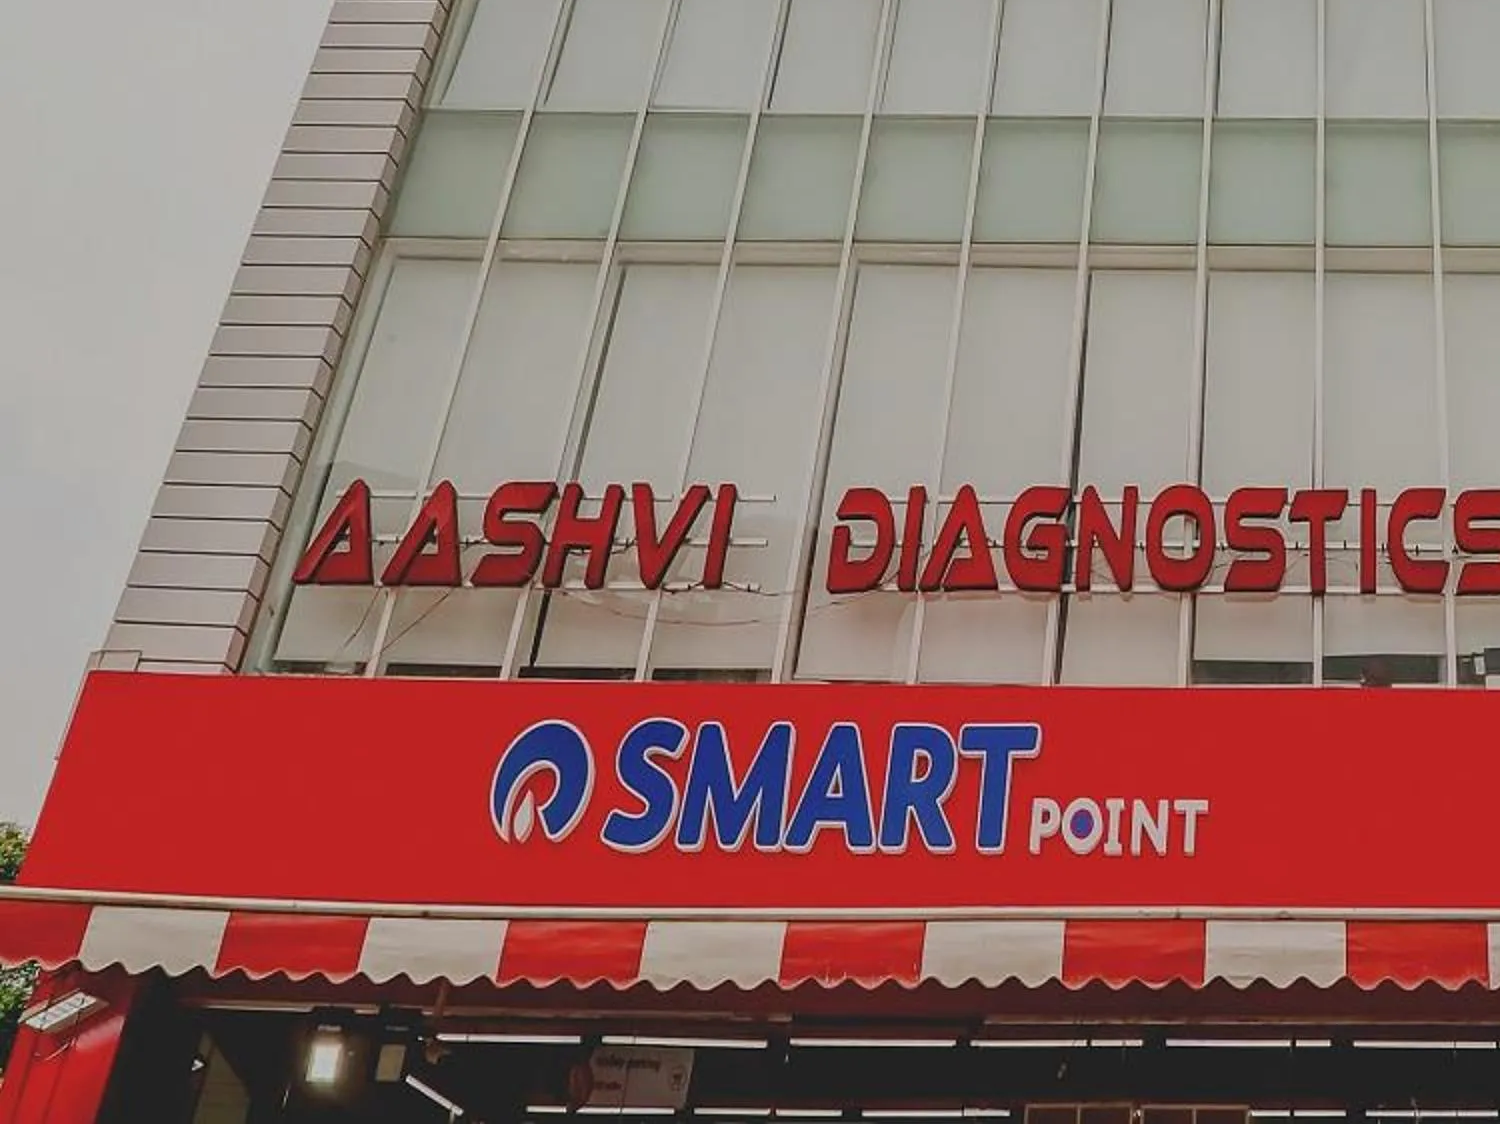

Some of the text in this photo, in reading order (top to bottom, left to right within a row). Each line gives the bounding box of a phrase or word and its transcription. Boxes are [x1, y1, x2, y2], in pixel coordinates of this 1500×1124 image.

[293, 479, 737, 589] AASHVI
[599, 717, 1209, 856] SMART POINT
